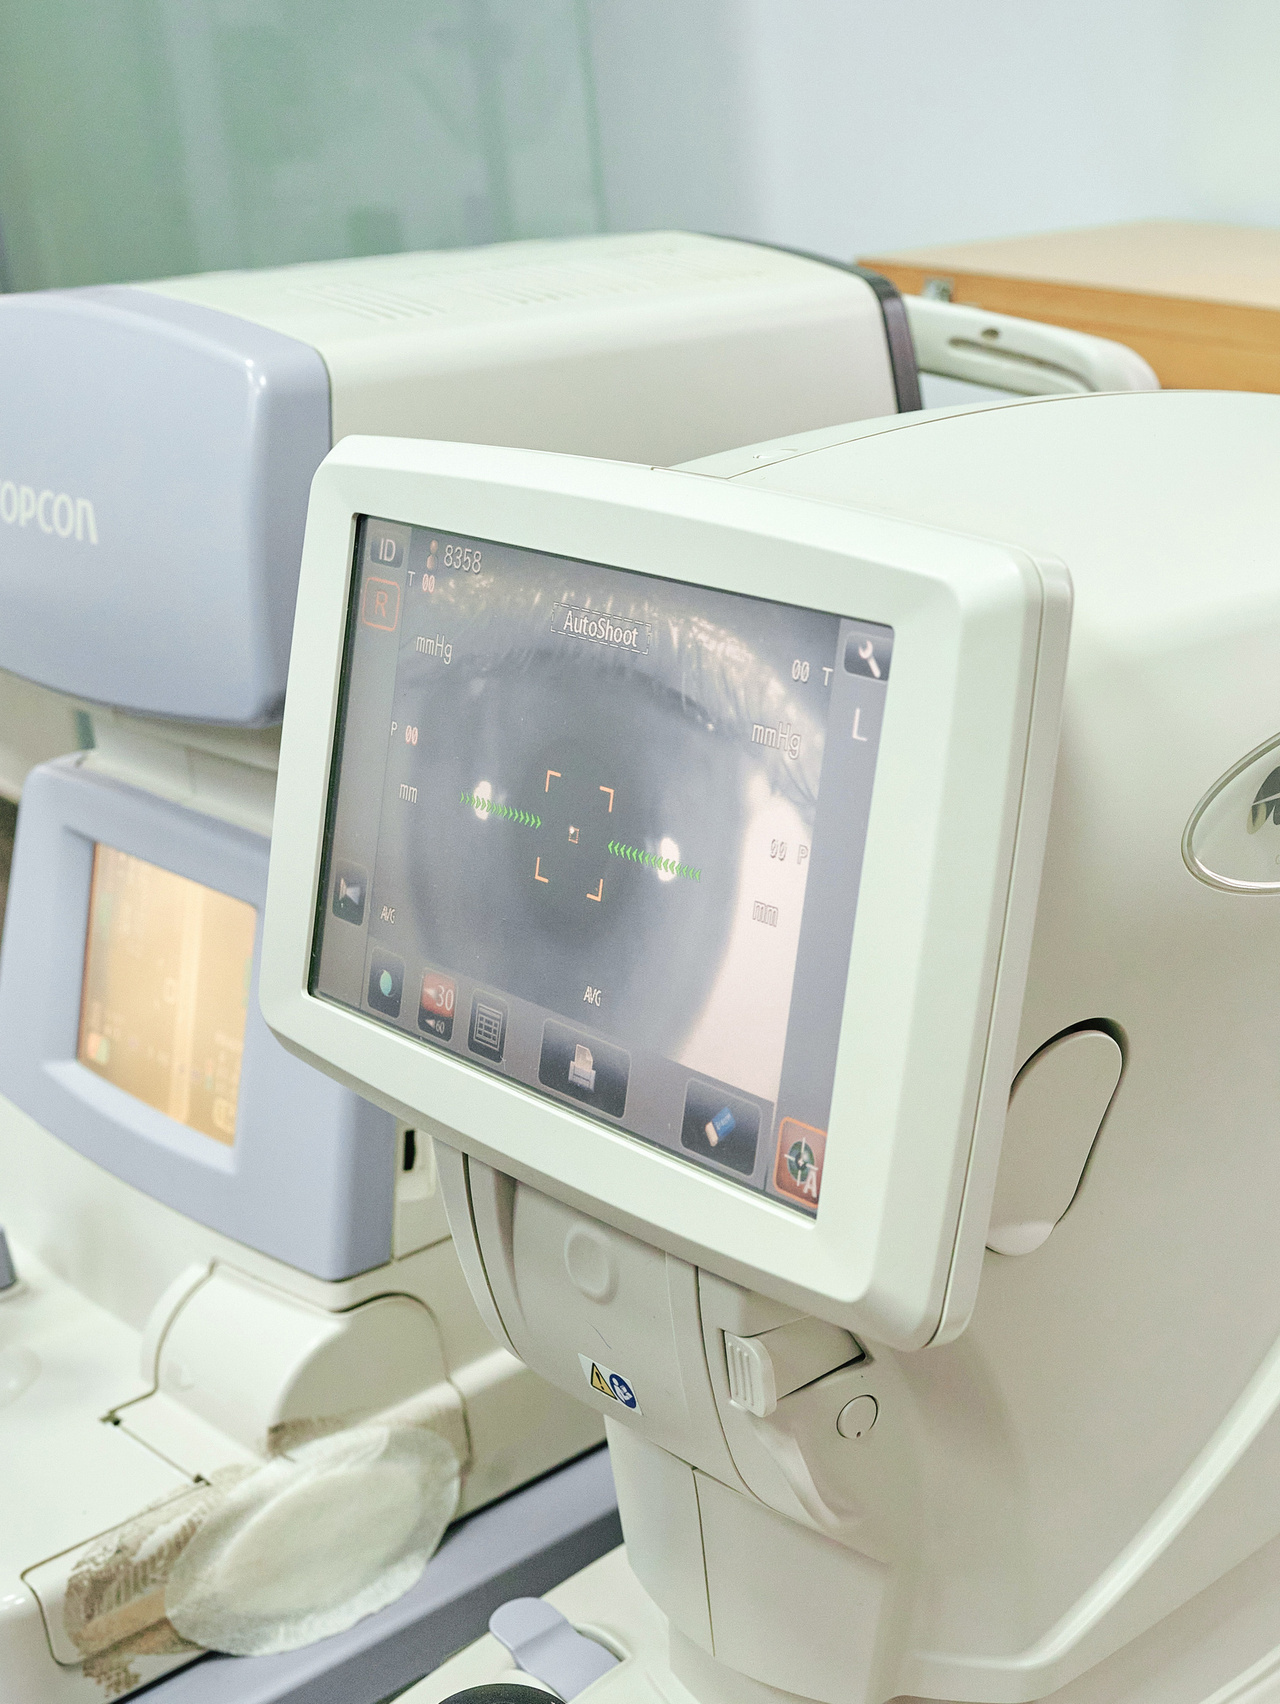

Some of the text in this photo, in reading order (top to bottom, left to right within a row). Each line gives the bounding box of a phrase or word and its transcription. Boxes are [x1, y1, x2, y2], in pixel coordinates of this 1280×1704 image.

[378, 538, 396, 562] ID
[443, 544, 482, 574] 8358
[407, 570, 416, 587] T
[375, 591, 388, 618] R
[563, 610, 639, 647] AutoShoot
[415, 633, 453, 665] mmHg
[822, 666, 834, 686] T
[390, 721, 398, 736] P
[852, 707, 868, 742] L
[751, 721, 801, 759] mmHg
[399, 783, 418, 804] mm
[797, 843, 809, 865] P
[752, 900, 779, 928] mm
[436, 984, 454, 1011] 30
[435, 1020, 445, 1034] 60
